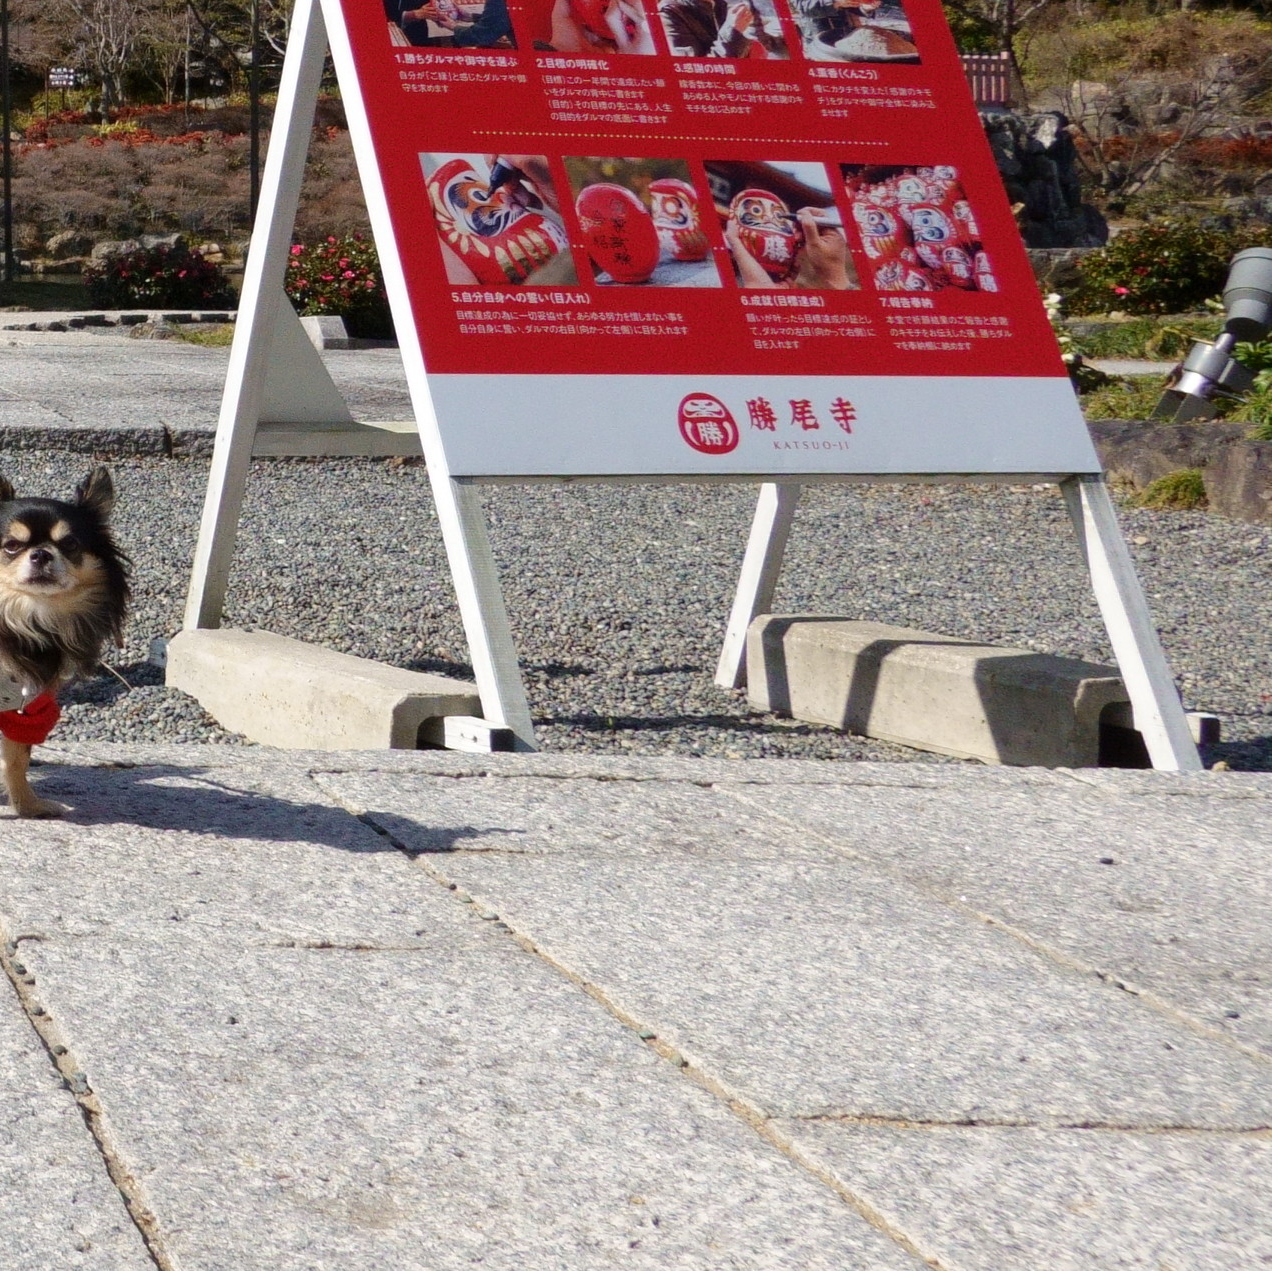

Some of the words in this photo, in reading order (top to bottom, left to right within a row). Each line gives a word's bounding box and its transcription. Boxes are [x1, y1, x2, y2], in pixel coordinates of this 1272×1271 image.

[394, 53, 519, 67] 1.勝ちダルマや御守を選ぶ
[536, 58, 610, 71] 2.目標の明確化
[674, 63, 736, 75] 3.感謝の時間
[762, 235, 790, 262] 勝
[745, 396, 857, 434] 勝尾寺
[698, 421, 724, 446] 勝
[773, 440, 850, 450] KATSUO-JI
